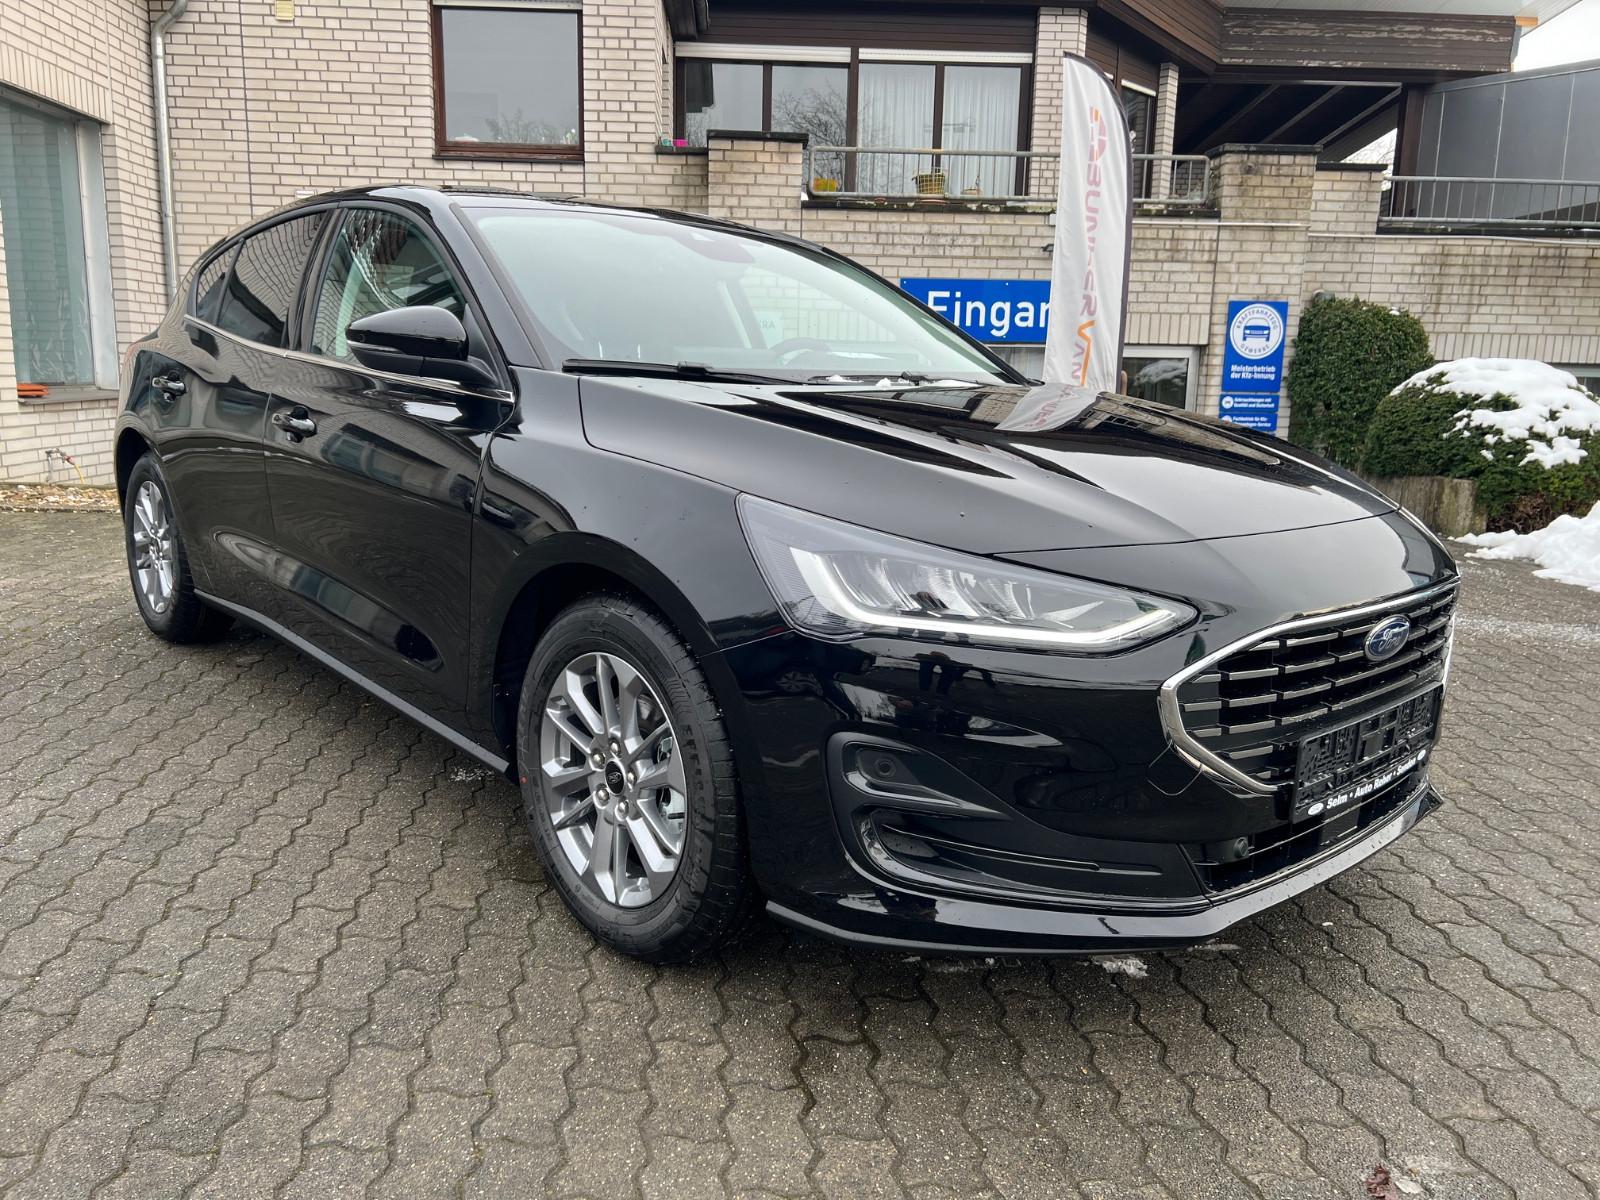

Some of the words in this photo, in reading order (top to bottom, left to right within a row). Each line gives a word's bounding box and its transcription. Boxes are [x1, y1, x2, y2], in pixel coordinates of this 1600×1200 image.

[1231, 364, 1276, 373] Meisterbetrieb
[1241, 372, 1275, 381] Kfz-Innung
[1326, 794, 1348, 809] Selm
[1354, 783, 1373, 798] Auto
